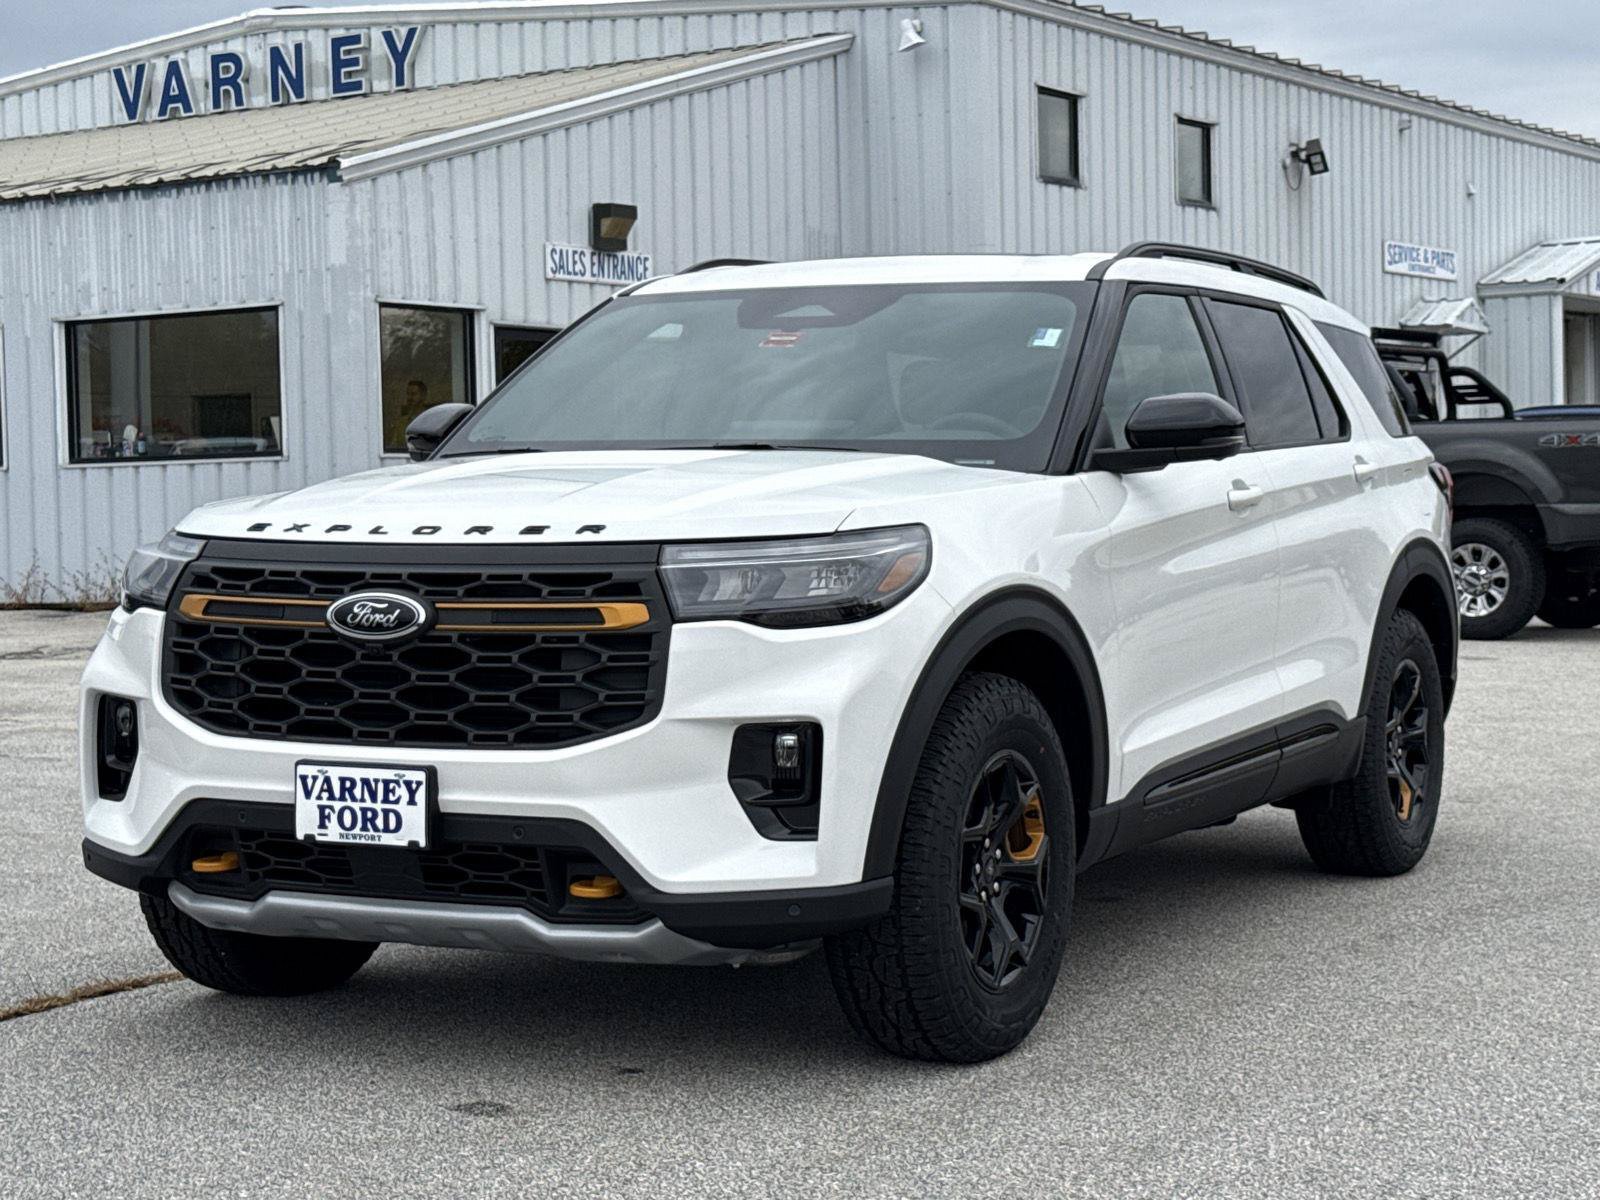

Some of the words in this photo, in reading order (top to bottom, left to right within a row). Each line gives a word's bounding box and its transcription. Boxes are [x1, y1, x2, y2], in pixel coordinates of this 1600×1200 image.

[112, 26, 419, 121] VARNEY
[550, 248, 586, 277] SALES
[590, 251, 650, 281] ENTRANCE
[1387, 243, 1421, 266] SERVICE
[1423, 248, 1429, 264] &
[1430, 250, 1455, 274] PARTS
[246, 522, 606, 536] EXPLORER
[347, 601, 401, 627] Ford
[299, 774, 423, 806] VARNEY
[317, 804, 403, 834] FORD
[338, 832, 382, 842] NEWPORT
